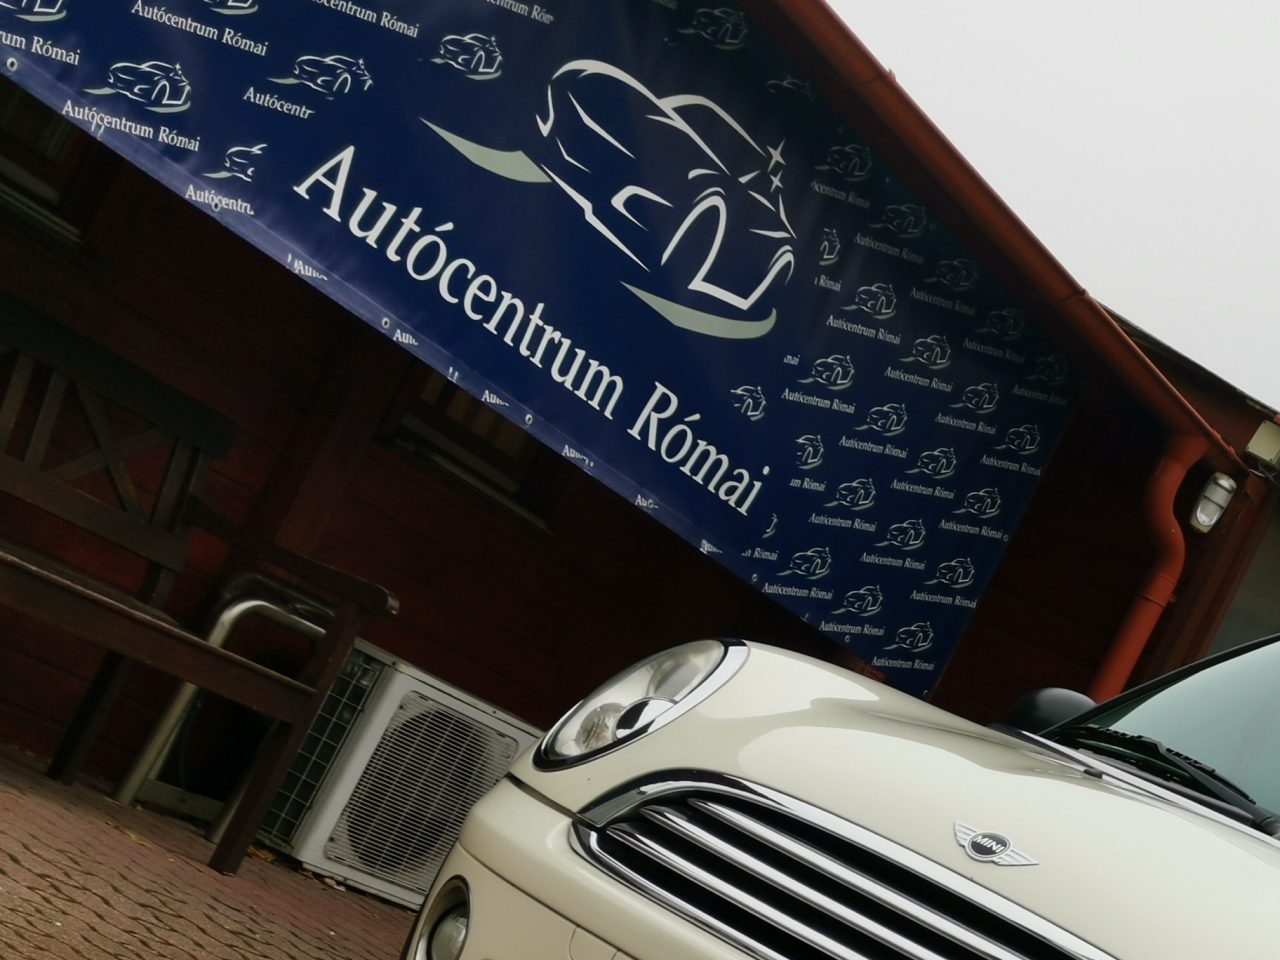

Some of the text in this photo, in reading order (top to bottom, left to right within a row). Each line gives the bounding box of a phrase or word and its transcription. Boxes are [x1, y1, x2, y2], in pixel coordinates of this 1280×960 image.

[131, 0, 269, 56] Autócentrum Római
[380, 11, 420, 38] Római
[0, 31, 80, 65] um Római
[62, 100, 200, 151] Autócentrum Római
[819, 274, 842, 292] Római
[293, 145, 770, 516] Autócentrum Római
[826, 314, 902, 345] Autócentrum Római
[884, 366, 953, 393] Autócentrum Római
[781, 387, 856, 415] Autócentrum Római
[935, 411, 976, 431] Autócentrum
[839, 435, 908, 459] Autócentrum Római
[980, 454, 1020, 472] Autócentrum
[802, 476, 827, 492] Római
[890, 478, 956, 500] Autócentrum Római
[808, 512, 877, 533] Autócentrum Római
[938, 518, 1003, 540] Autócentrum Római
[753, 547, 779, 561] Római
[860, 552, 928, 571] Autócentrum Római
[762, 582, 834, 600] Autócentrum Római
[910, 589, 977, 609] Autócentrum Római
[818, 620, 886, 637] Autócentrum Római
[871, 656, 936, 671] Autócentrum Római
[973, 835, 1006, 853] MINI
